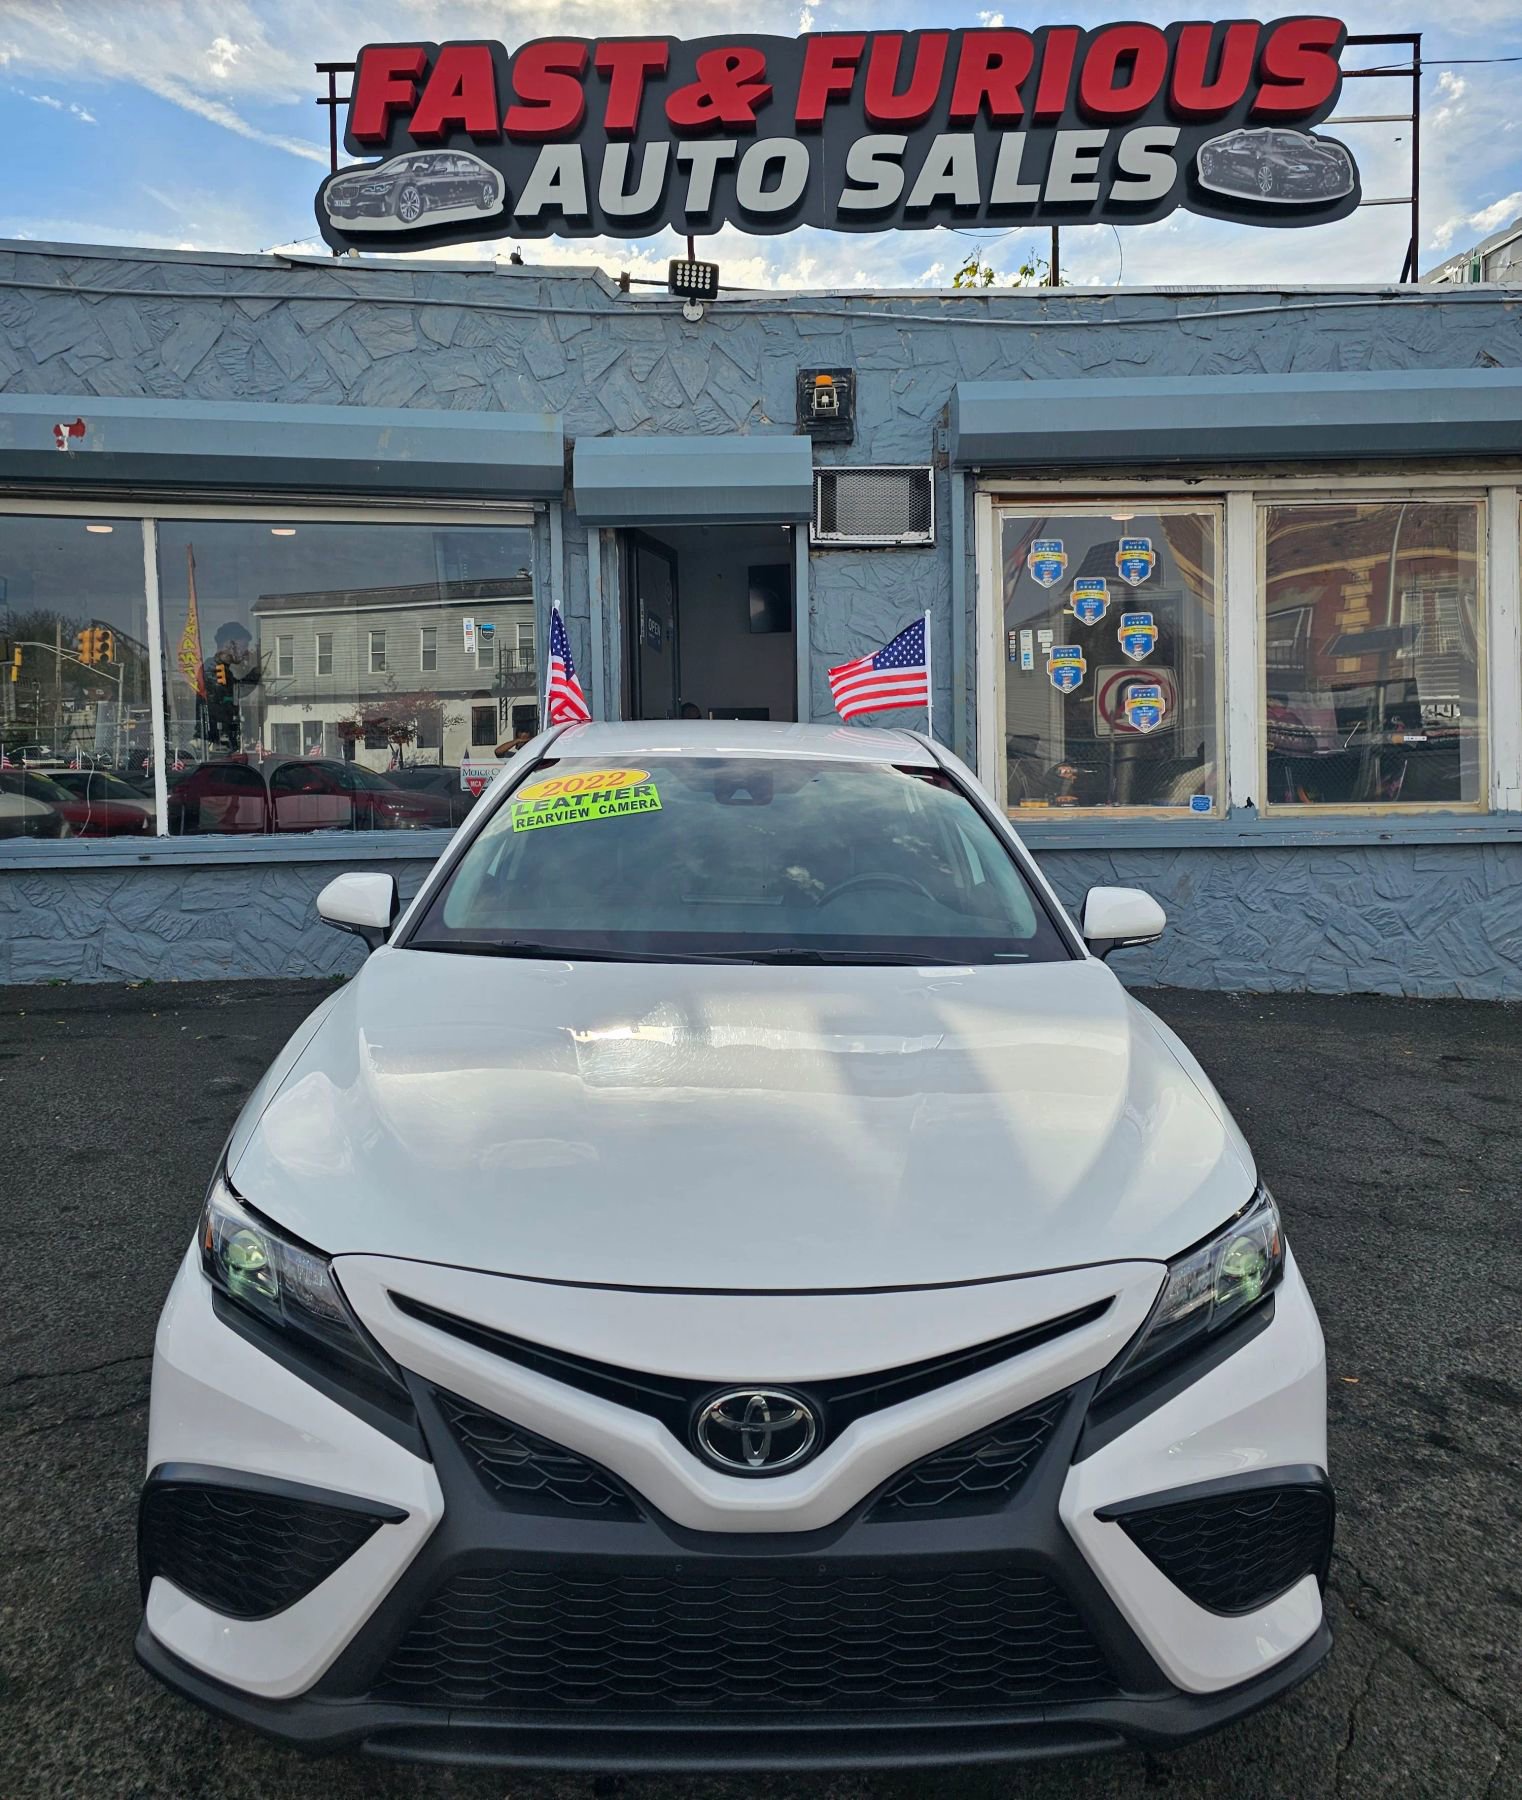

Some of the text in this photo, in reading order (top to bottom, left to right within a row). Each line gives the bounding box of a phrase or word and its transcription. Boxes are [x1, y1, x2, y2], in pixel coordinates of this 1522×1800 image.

[351, 18, 1344, 142] FAST & FURIOUS
[514, 126, 1181, 218] AUTO SALES
[539, 771, 627, 797] 2022
[515, 785, 652, 817] LEATHER
[516, 798, 659, 829] REARVIEW CAMERA
